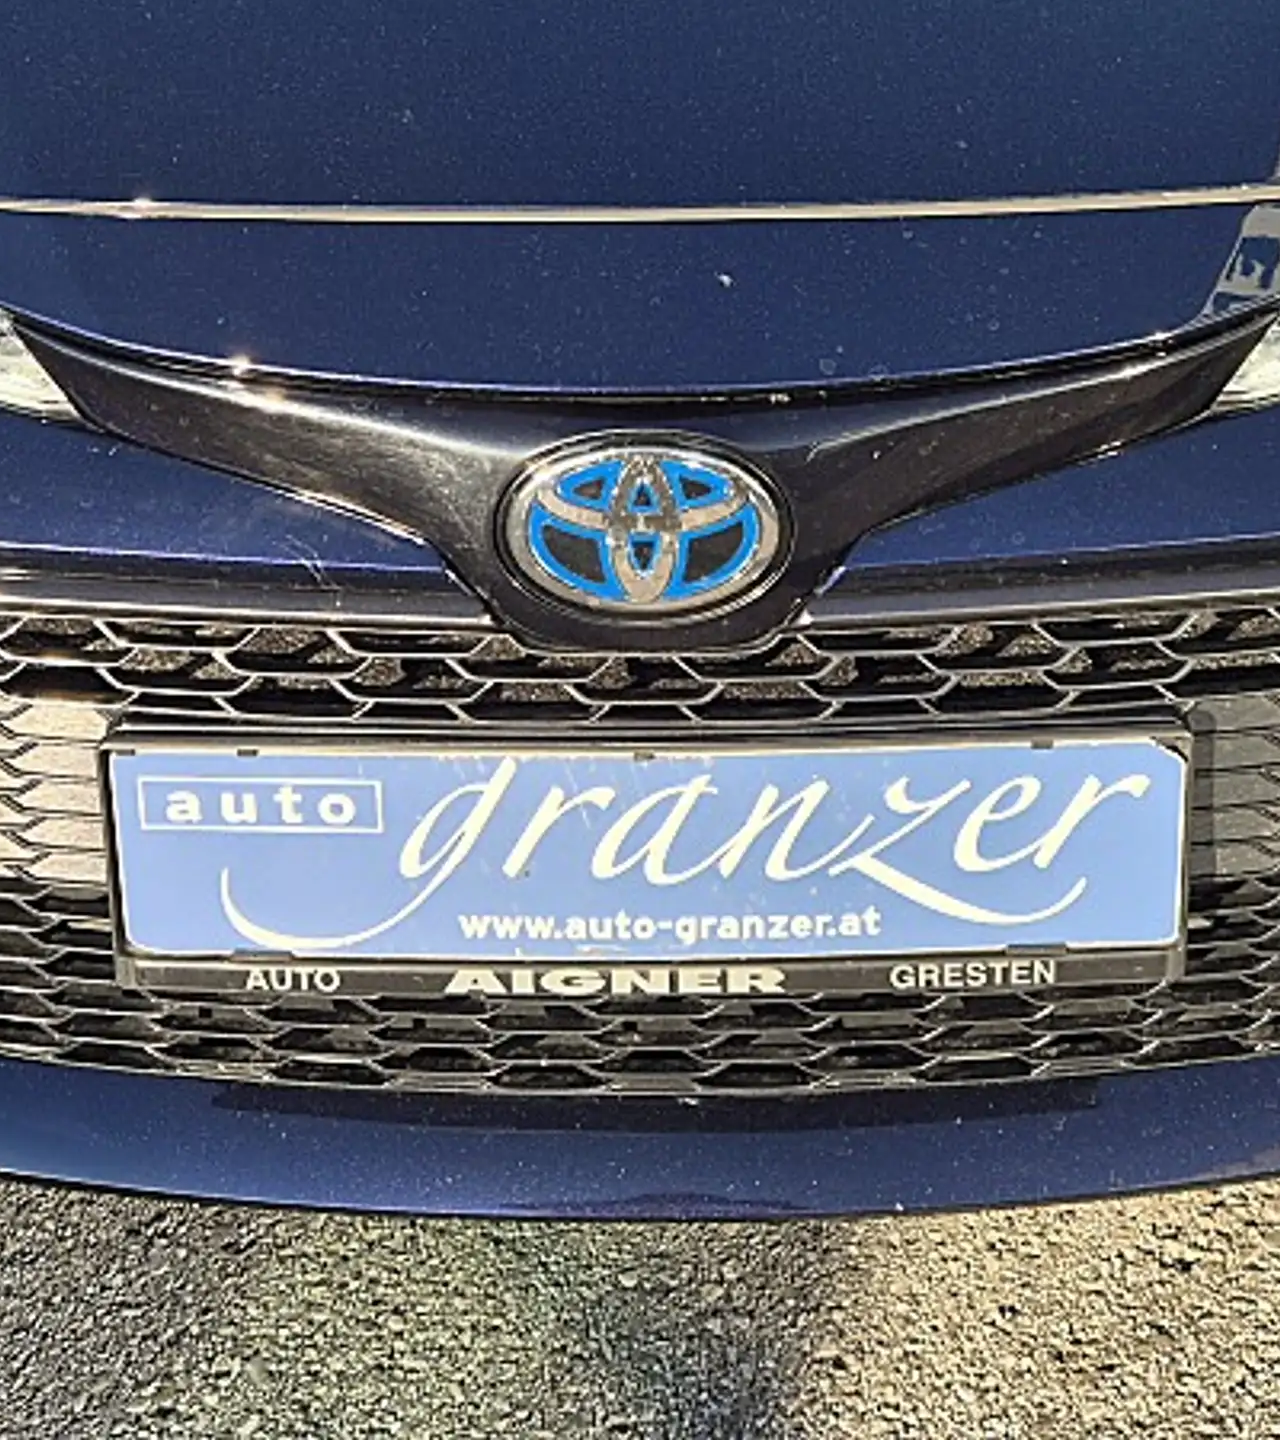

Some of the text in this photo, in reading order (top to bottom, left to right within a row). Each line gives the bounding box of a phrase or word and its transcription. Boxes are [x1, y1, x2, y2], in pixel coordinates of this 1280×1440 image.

[164, 756, 1151, 950] auto granzer
[458, 905, 882, 945] www.auto-granzer.at
[244, 960, 1057, 995] AUTO AIGNER GRESTEN
